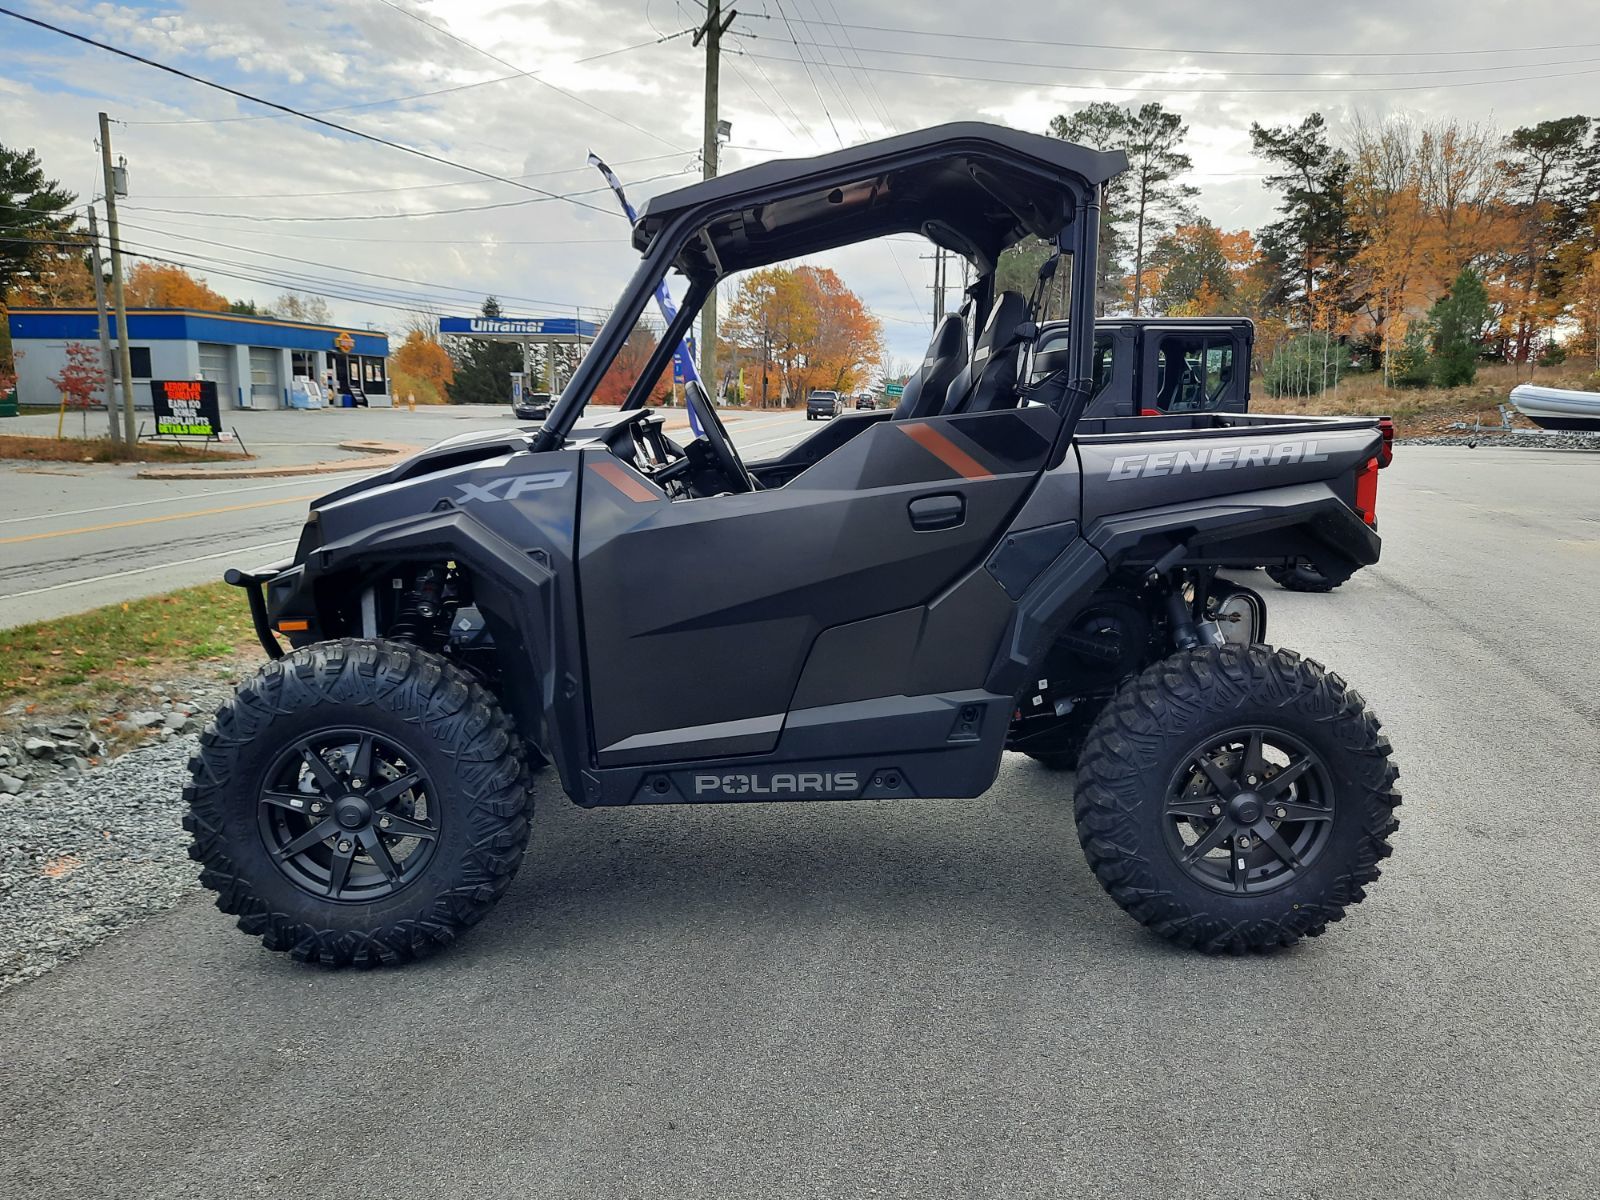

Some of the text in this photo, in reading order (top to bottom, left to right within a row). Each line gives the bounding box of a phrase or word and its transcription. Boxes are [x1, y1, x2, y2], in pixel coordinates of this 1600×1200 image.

[470, 318, 545, 333] Ultramar
[164, 382, 201, 391] AEROPLAN
[167, 391, 201, 400] SUNDAYS
[168, 399, 201, 409] EARN 100
[173, 408, 197, 417] BONUS
[159, 416, 210, 426] AEROPLAN PTS
[159, 424, 213, 434] DETAILS INSIDE
[1107, 440, 1330, 482] GENERAL
[453, 471, 572, 504] XP
[695, 771, 859, 794] POLARIS
